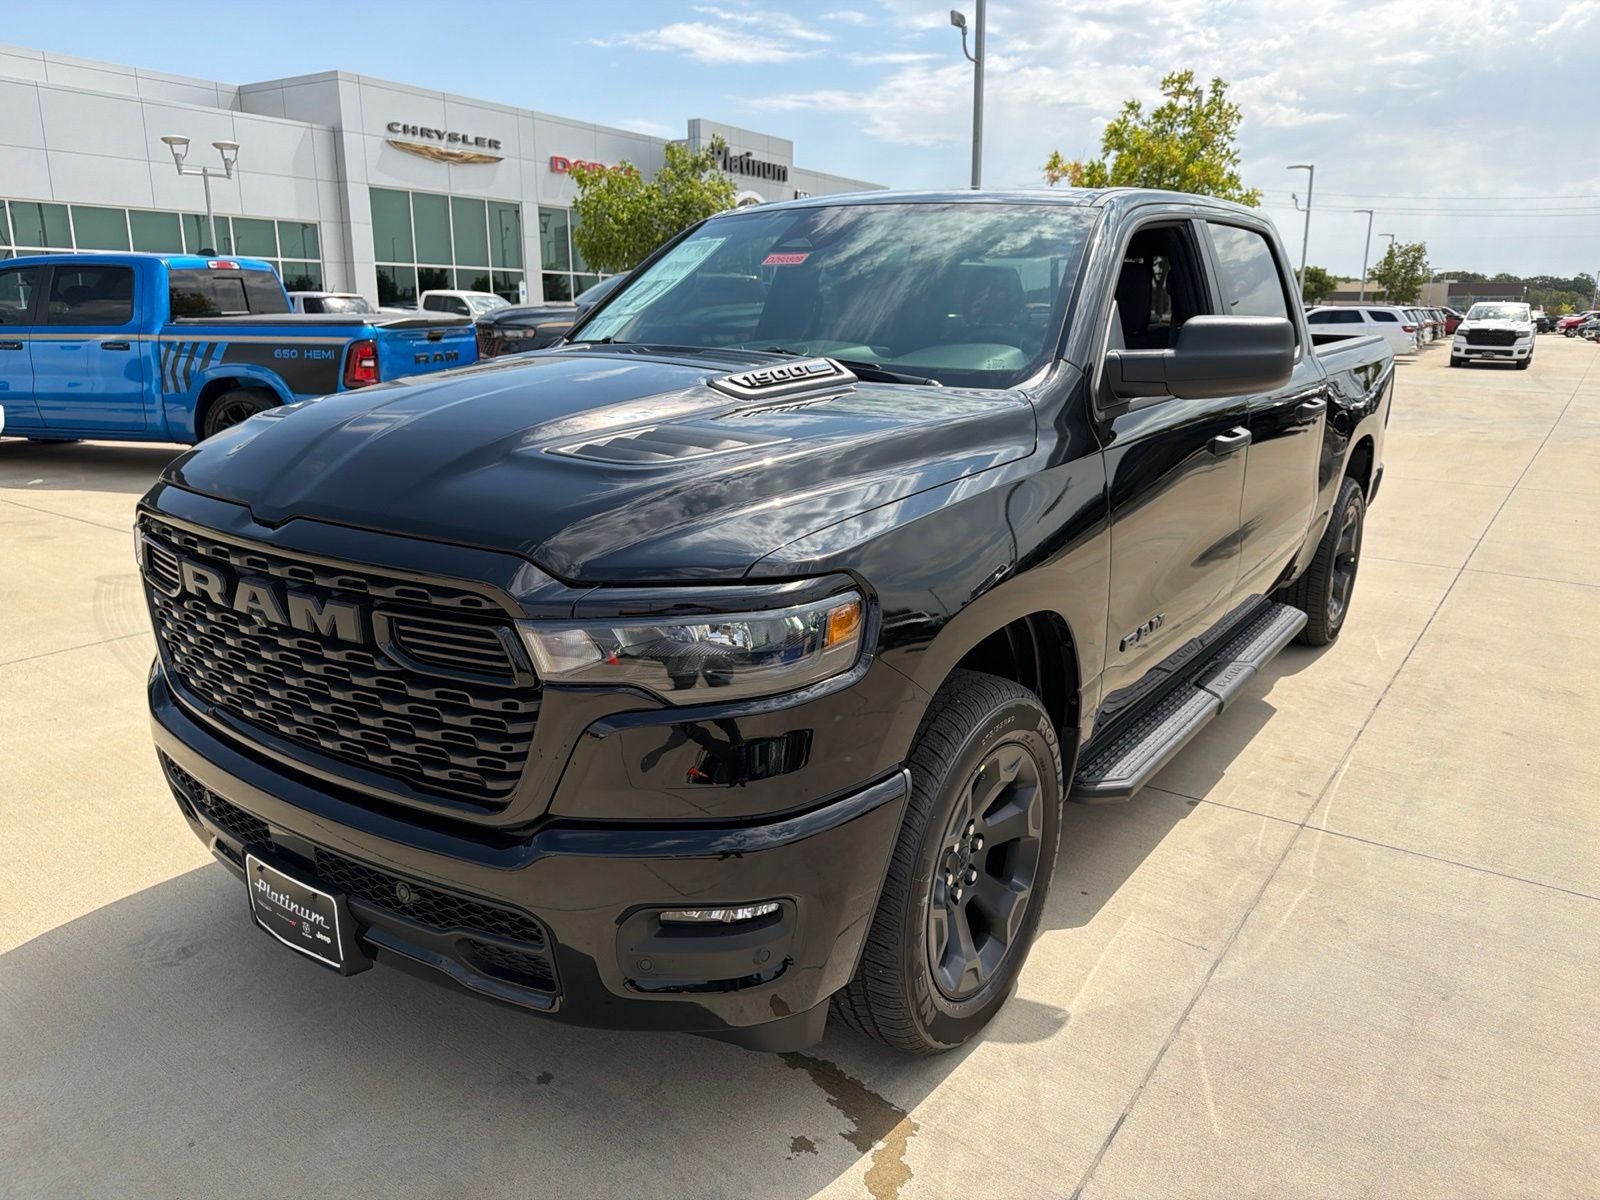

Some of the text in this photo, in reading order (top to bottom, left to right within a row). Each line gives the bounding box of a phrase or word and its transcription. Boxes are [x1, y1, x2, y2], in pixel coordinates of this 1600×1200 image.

[386, 121, 502, 150] CHRYSLER
[274, 348, 335, 361] 650 HEMI
[414, 350, 460, 365] RAM
[742, 365, 807, 386] 1500
[182, 562, 364, 644] RAM
[253, 878, 331, 930] Platinum
